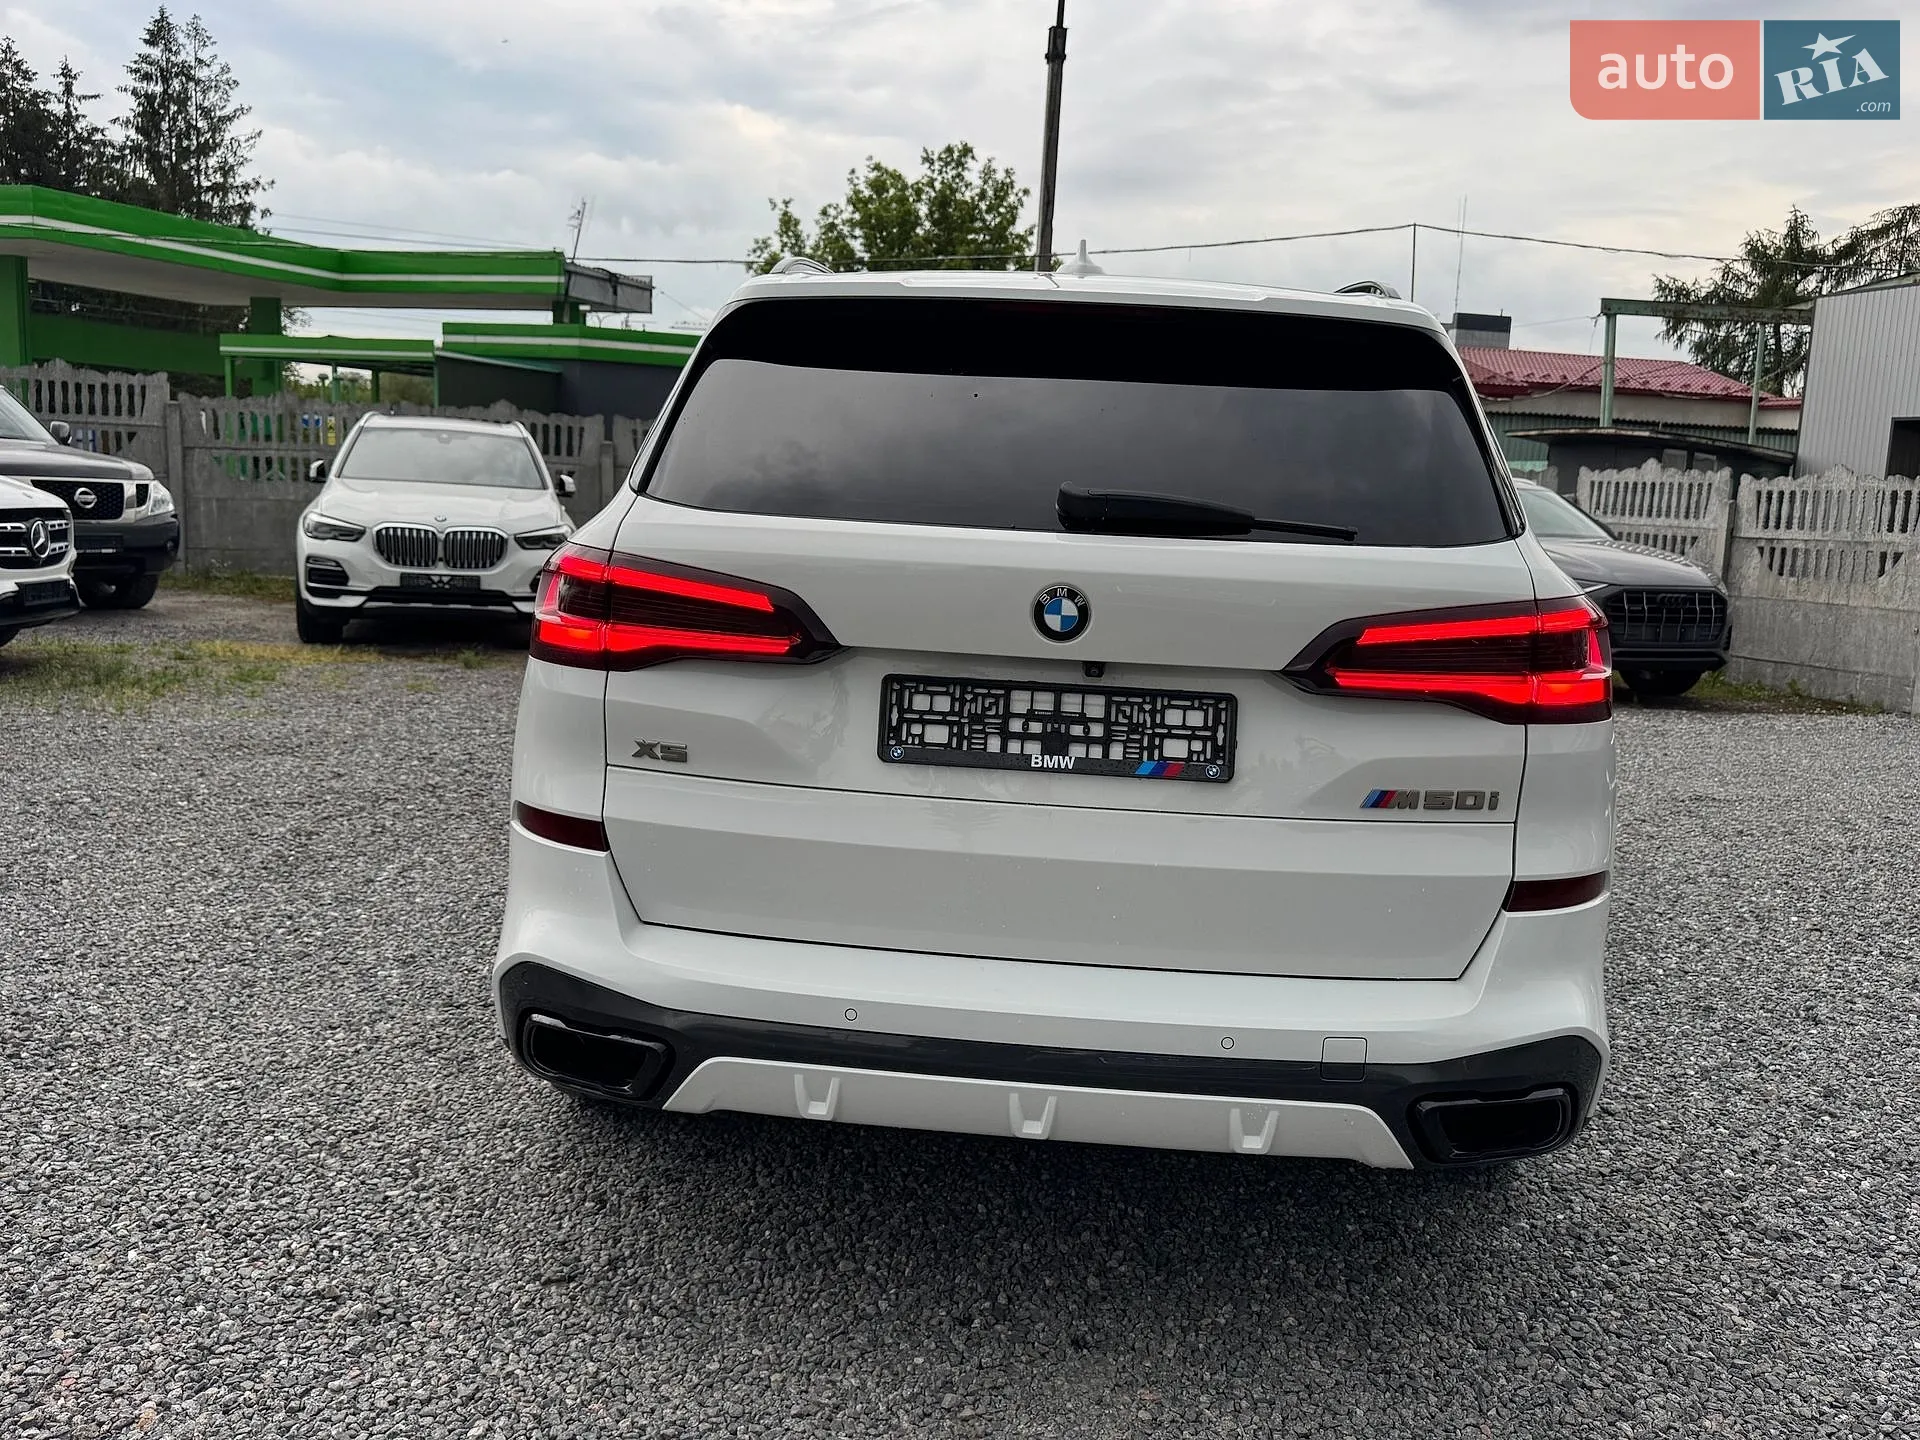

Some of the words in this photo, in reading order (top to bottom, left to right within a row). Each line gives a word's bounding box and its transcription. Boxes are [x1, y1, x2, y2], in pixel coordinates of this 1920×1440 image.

[1039, 588, 1086, 607] BMW
[632, 739, 687, 763] X5
[1030, 754, 1076, 770] BMW
[1385, 788, 1500, 811] M50i
